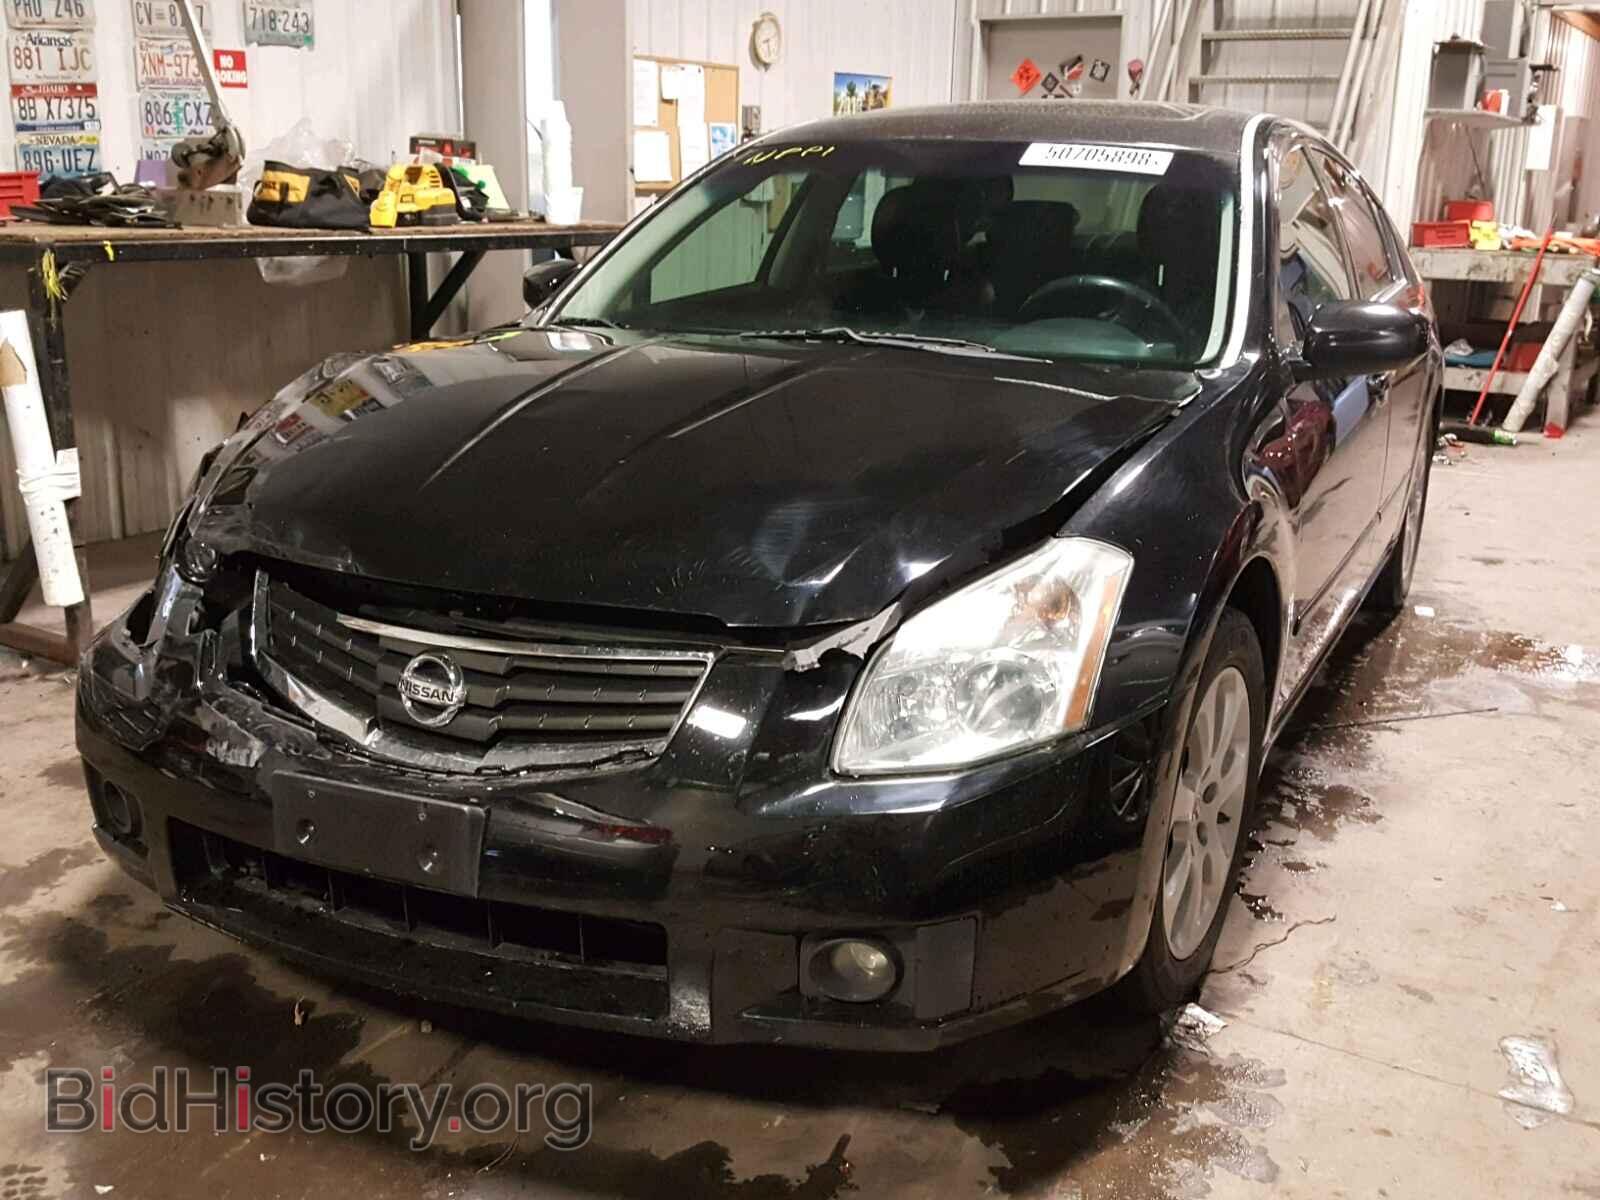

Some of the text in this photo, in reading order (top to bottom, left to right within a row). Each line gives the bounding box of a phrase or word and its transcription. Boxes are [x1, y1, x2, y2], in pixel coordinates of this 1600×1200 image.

[135, 1, 152, 26] CV
[25, 31, 73, 47] Arkansas
[13, 46, 42, 70] 881
[219, 54, 235, 69] NO
[44, 96, 95, 120] X7375
[144, 101, 173, 126] 886
[36, 135, 77, 145] NEVADA
[400, 679, 455, 702] NISSAN
